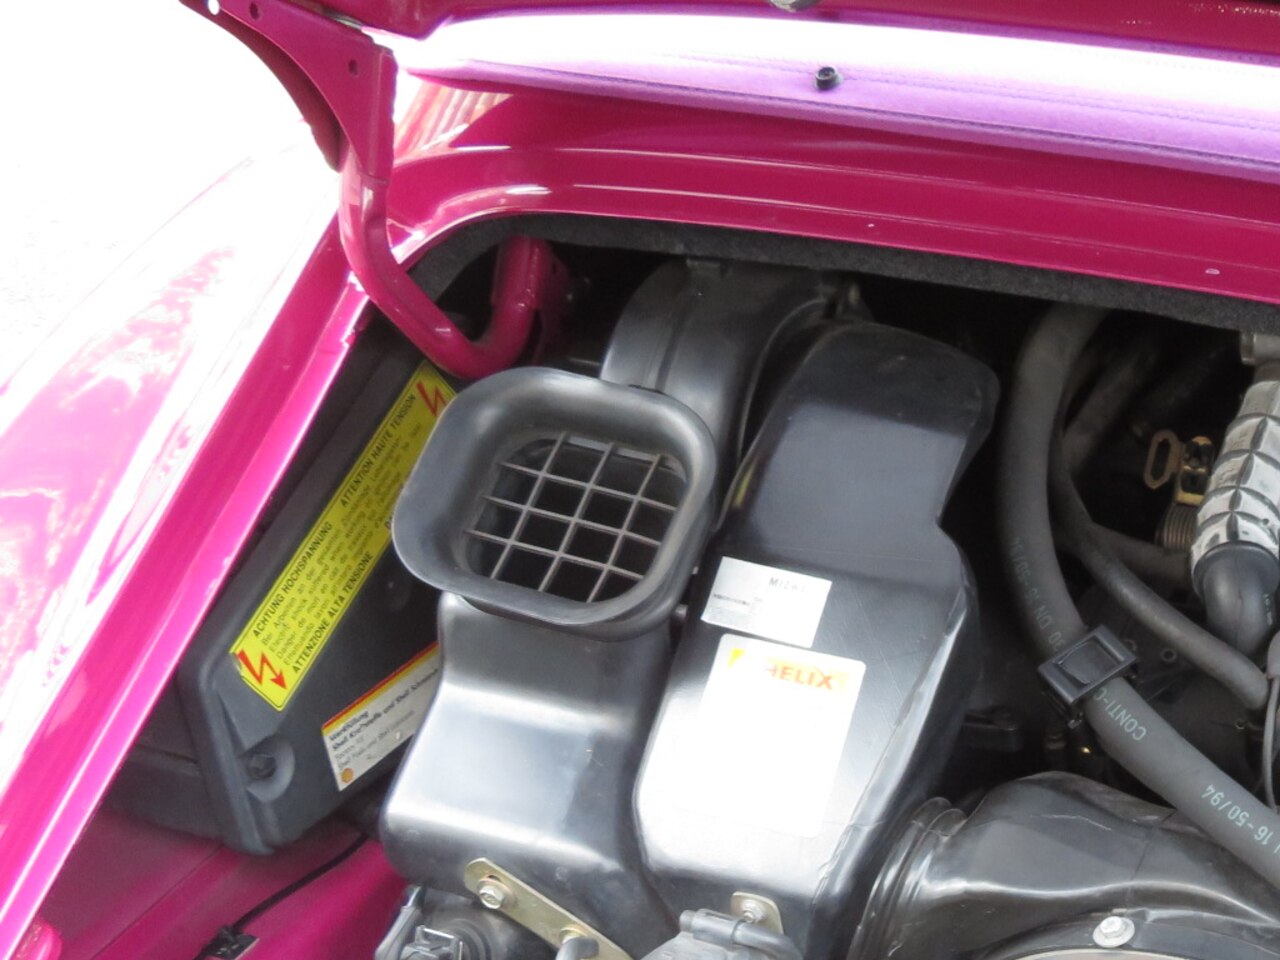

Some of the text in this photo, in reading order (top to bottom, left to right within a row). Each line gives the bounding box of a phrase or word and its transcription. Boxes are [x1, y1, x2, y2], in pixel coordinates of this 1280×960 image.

[338, 391, 417, 507] ATTENTION HAUTE TENSION
[251, 519, 333, 638] ACHTUNG HOCHSPANNUNG
[291, 550, 373, 674] ATTENZIONE ALTA TENSIONE
